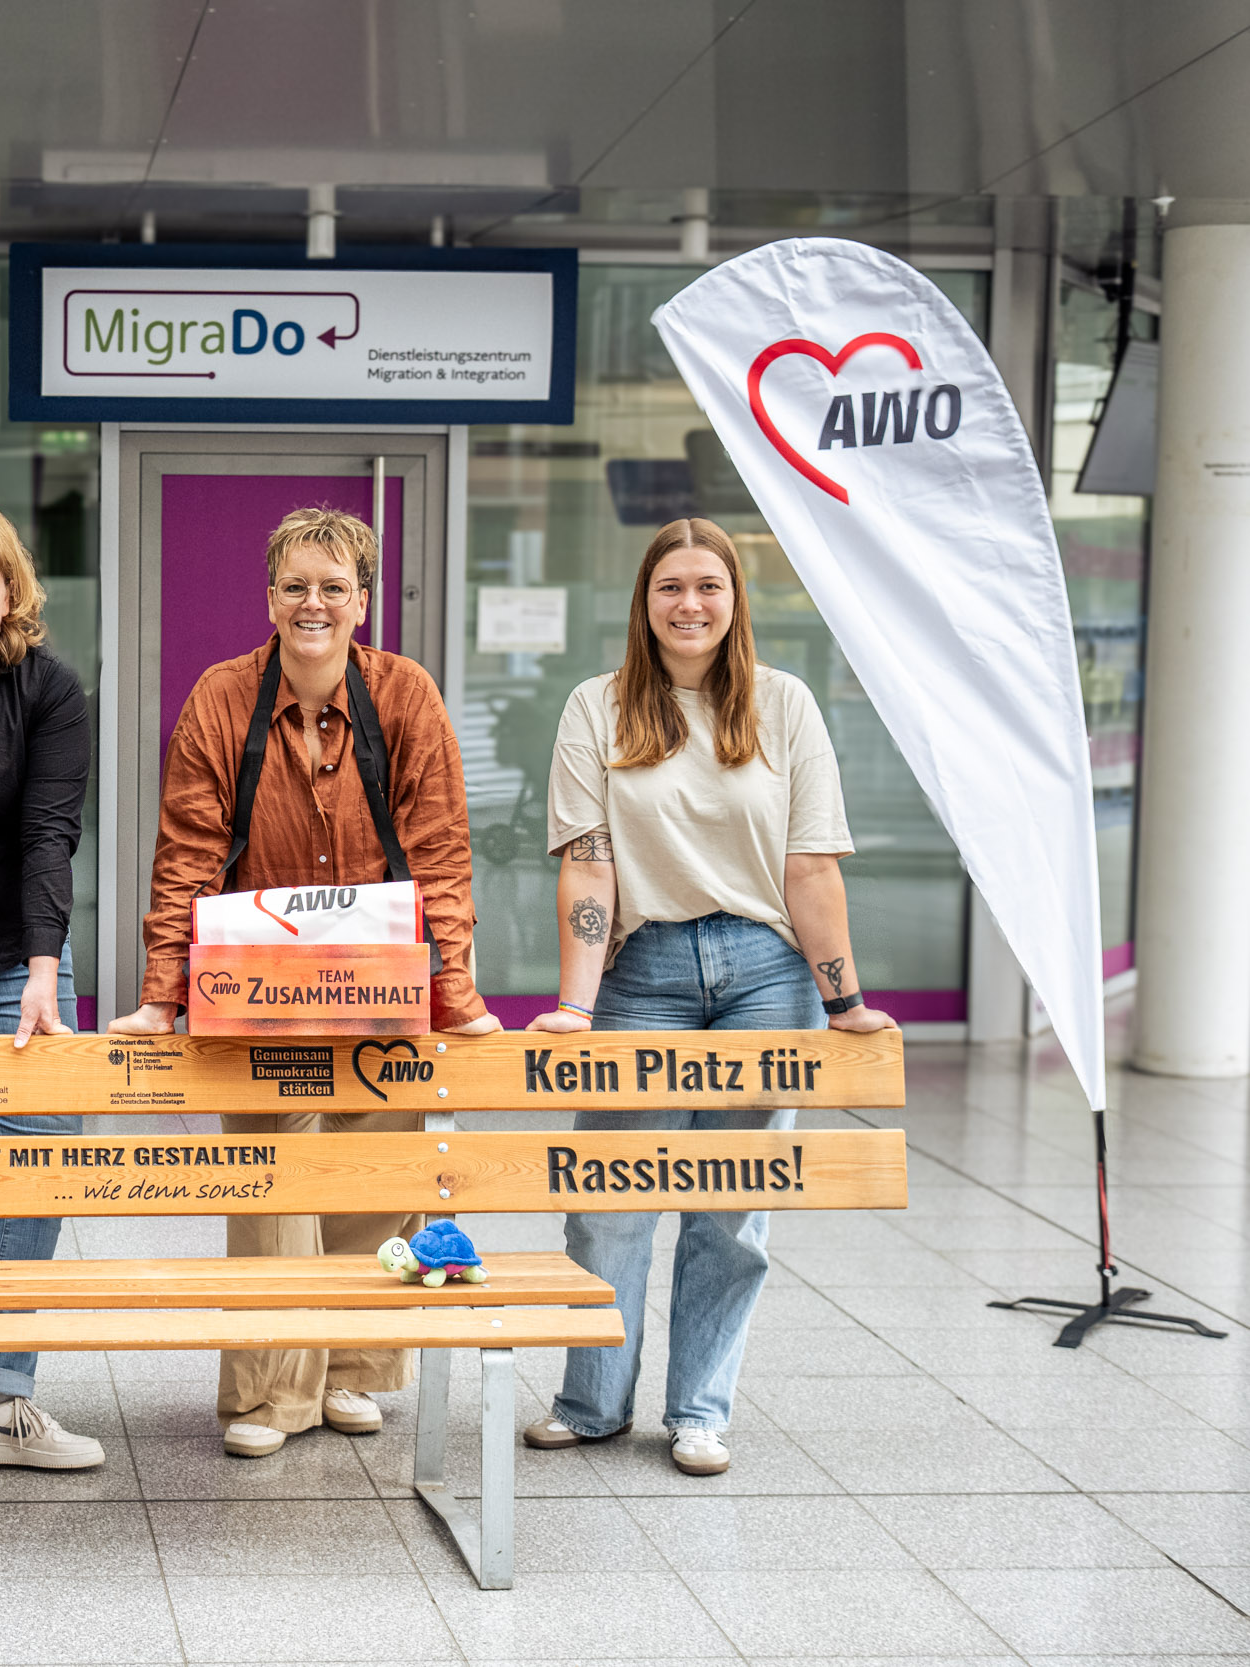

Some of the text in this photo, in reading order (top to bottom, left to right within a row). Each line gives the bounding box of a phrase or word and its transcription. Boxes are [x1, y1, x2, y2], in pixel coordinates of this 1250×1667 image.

[84, 308, 305, 365] MigraDo
[367, 348, 532, 366] Dienstleistungszentrum
[367, 366, 527, 383] Migration & Integration
[817, 383, 962, 450] AWO
[283, 887, 357, 916] AWO
[317, 969, 355, 983] TEAM
[210, 977, 424, 1005] AWO ZUSAMMENHALT
[253, 1048, 330, 1061] Gemeinsam
[256, 1065, 331, 1078] Demokratie
[377, 1060, 434, 1083] AWO
[525, 1048, 822, 1093] Kein Platz für
[281, 1081, 331, 1095] stärken
[9, 1148, 52, 1167] MIT
[61, 1147, 126, 1167] HERZ
[133, 1145, 277, 1166] GESTALTEN!
[546, 1145, 804, 1194] Rassismus!
[84, 1181, 122, 1200] wie
[127, 1178, 191, 1199] denn
[195, 1179, 274, 1199] sonst?
